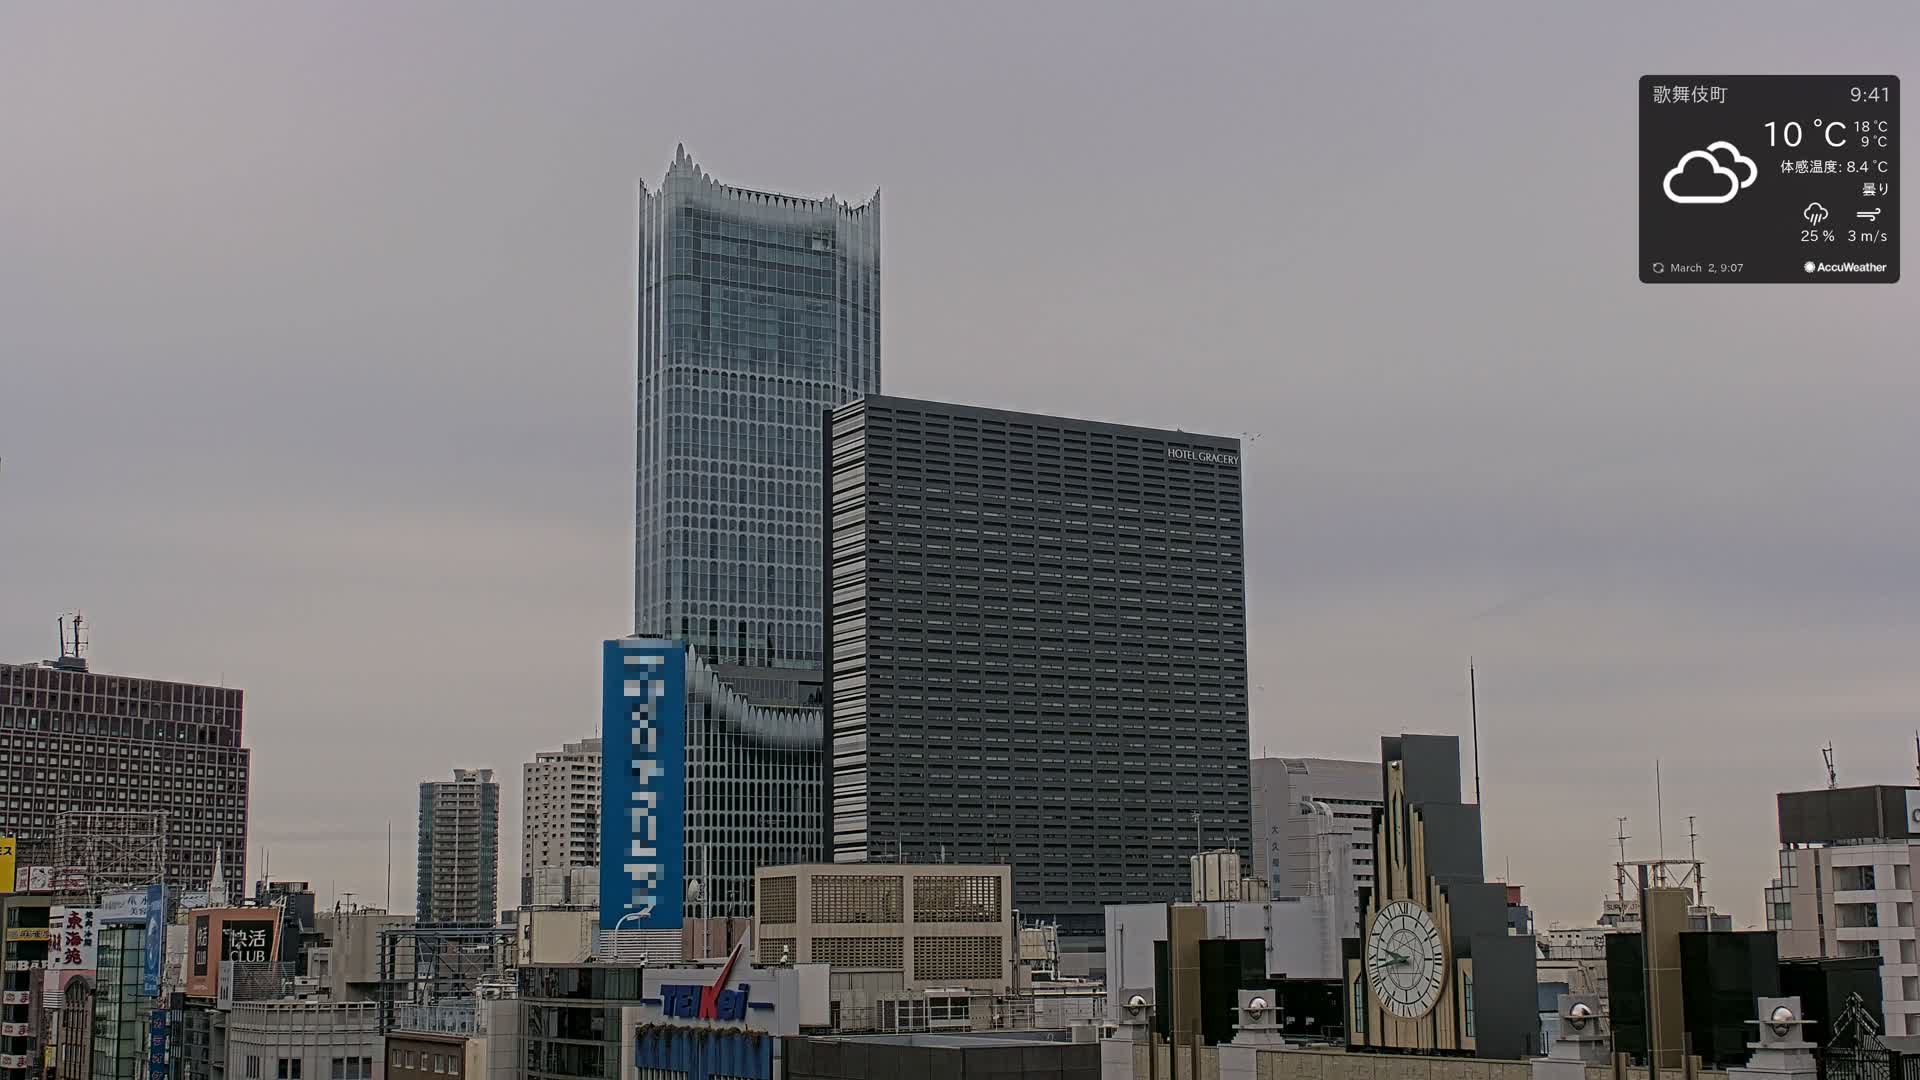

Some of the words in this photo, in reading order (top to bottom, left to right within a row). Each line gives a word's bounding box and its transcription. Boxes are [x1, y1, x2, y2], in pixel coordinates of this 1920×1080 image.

[1168, 448, 1197, 460] HOTEL
[1199, 451, 1239, 465] GRACERY
[63, 911, 83, 964] 東海苑
[231, 929, 266, 947] 快活
[230, 950, 265, 963] CLUB
